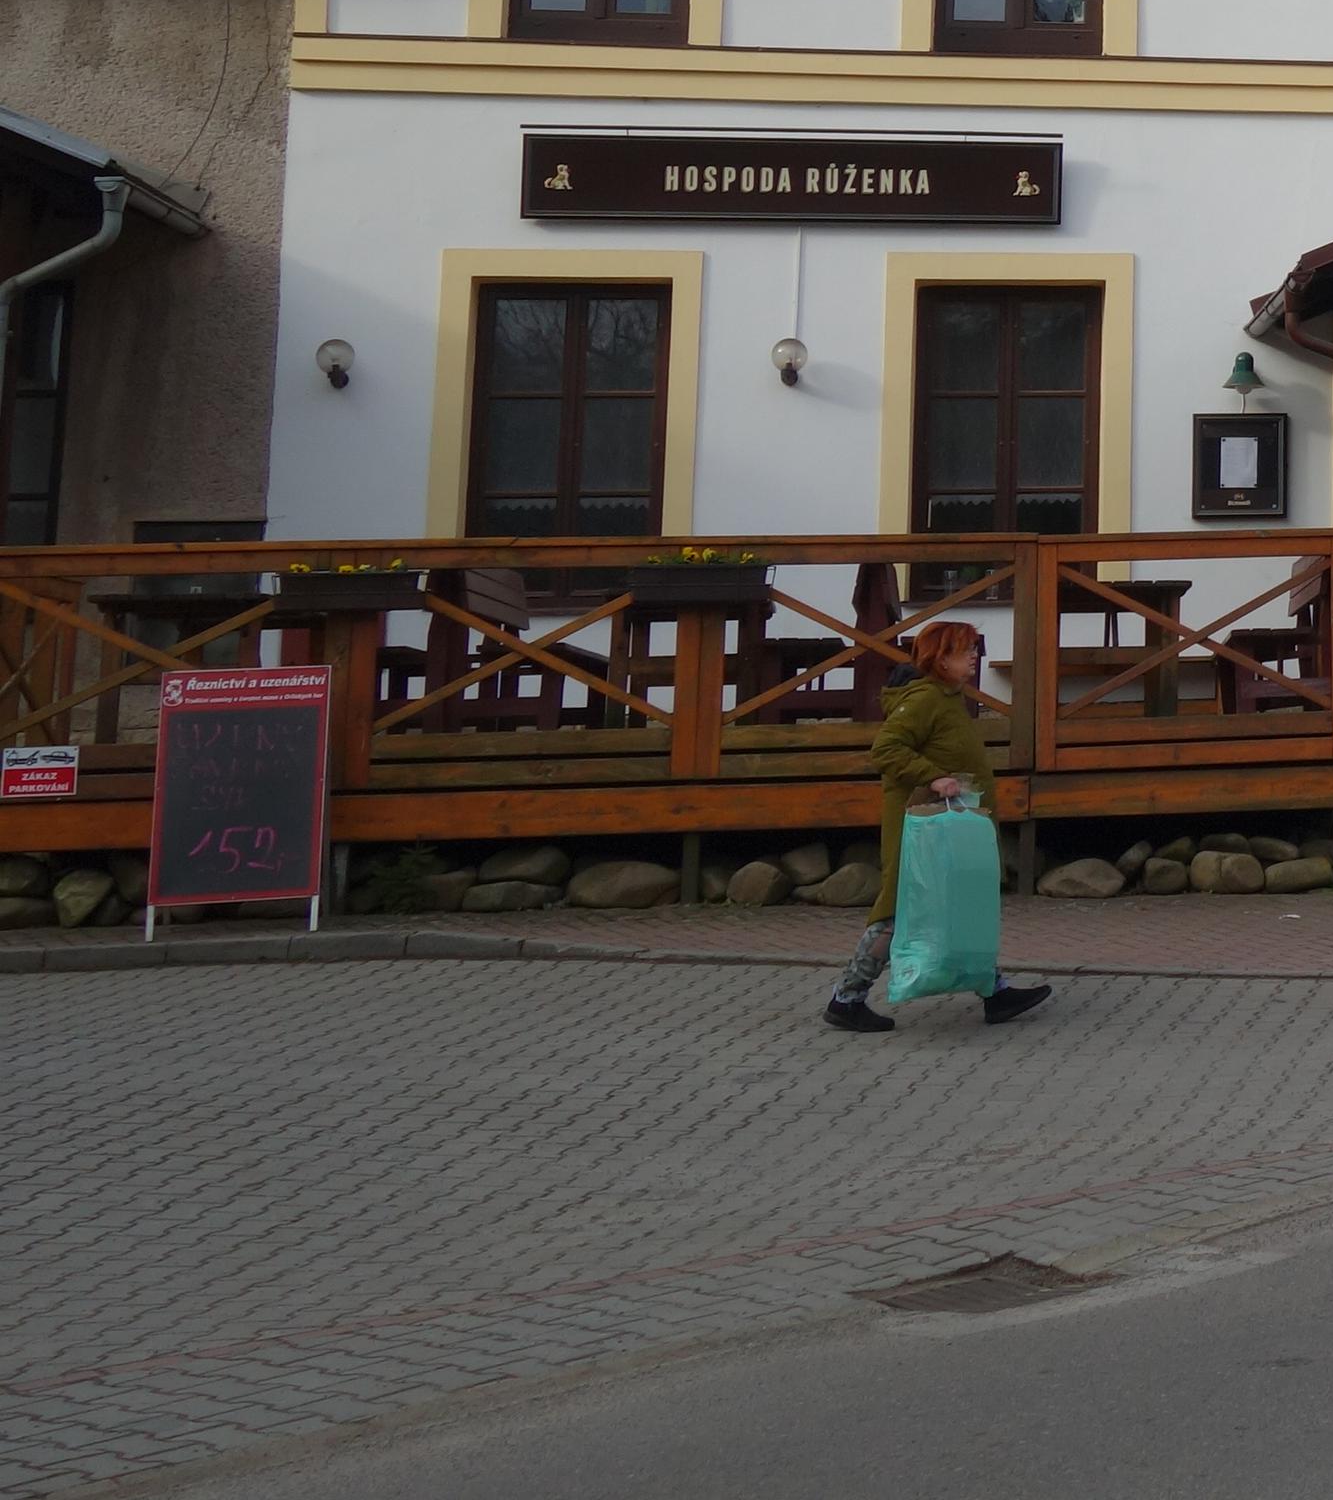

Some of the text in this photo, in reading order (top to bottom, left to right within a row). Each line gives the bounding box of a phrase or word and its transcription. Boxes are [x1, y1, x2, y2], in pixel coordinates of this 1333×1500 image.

[664, 163, 931, 195] HOSPODA RŮŽENKA
[248, 679, 256, 688] a
[260, 674, 327, 687] uzenářství
[21, 772, 58, 781] ZÁKAZ
[8, 781, 69, 793] PARKOVÁNÍ
